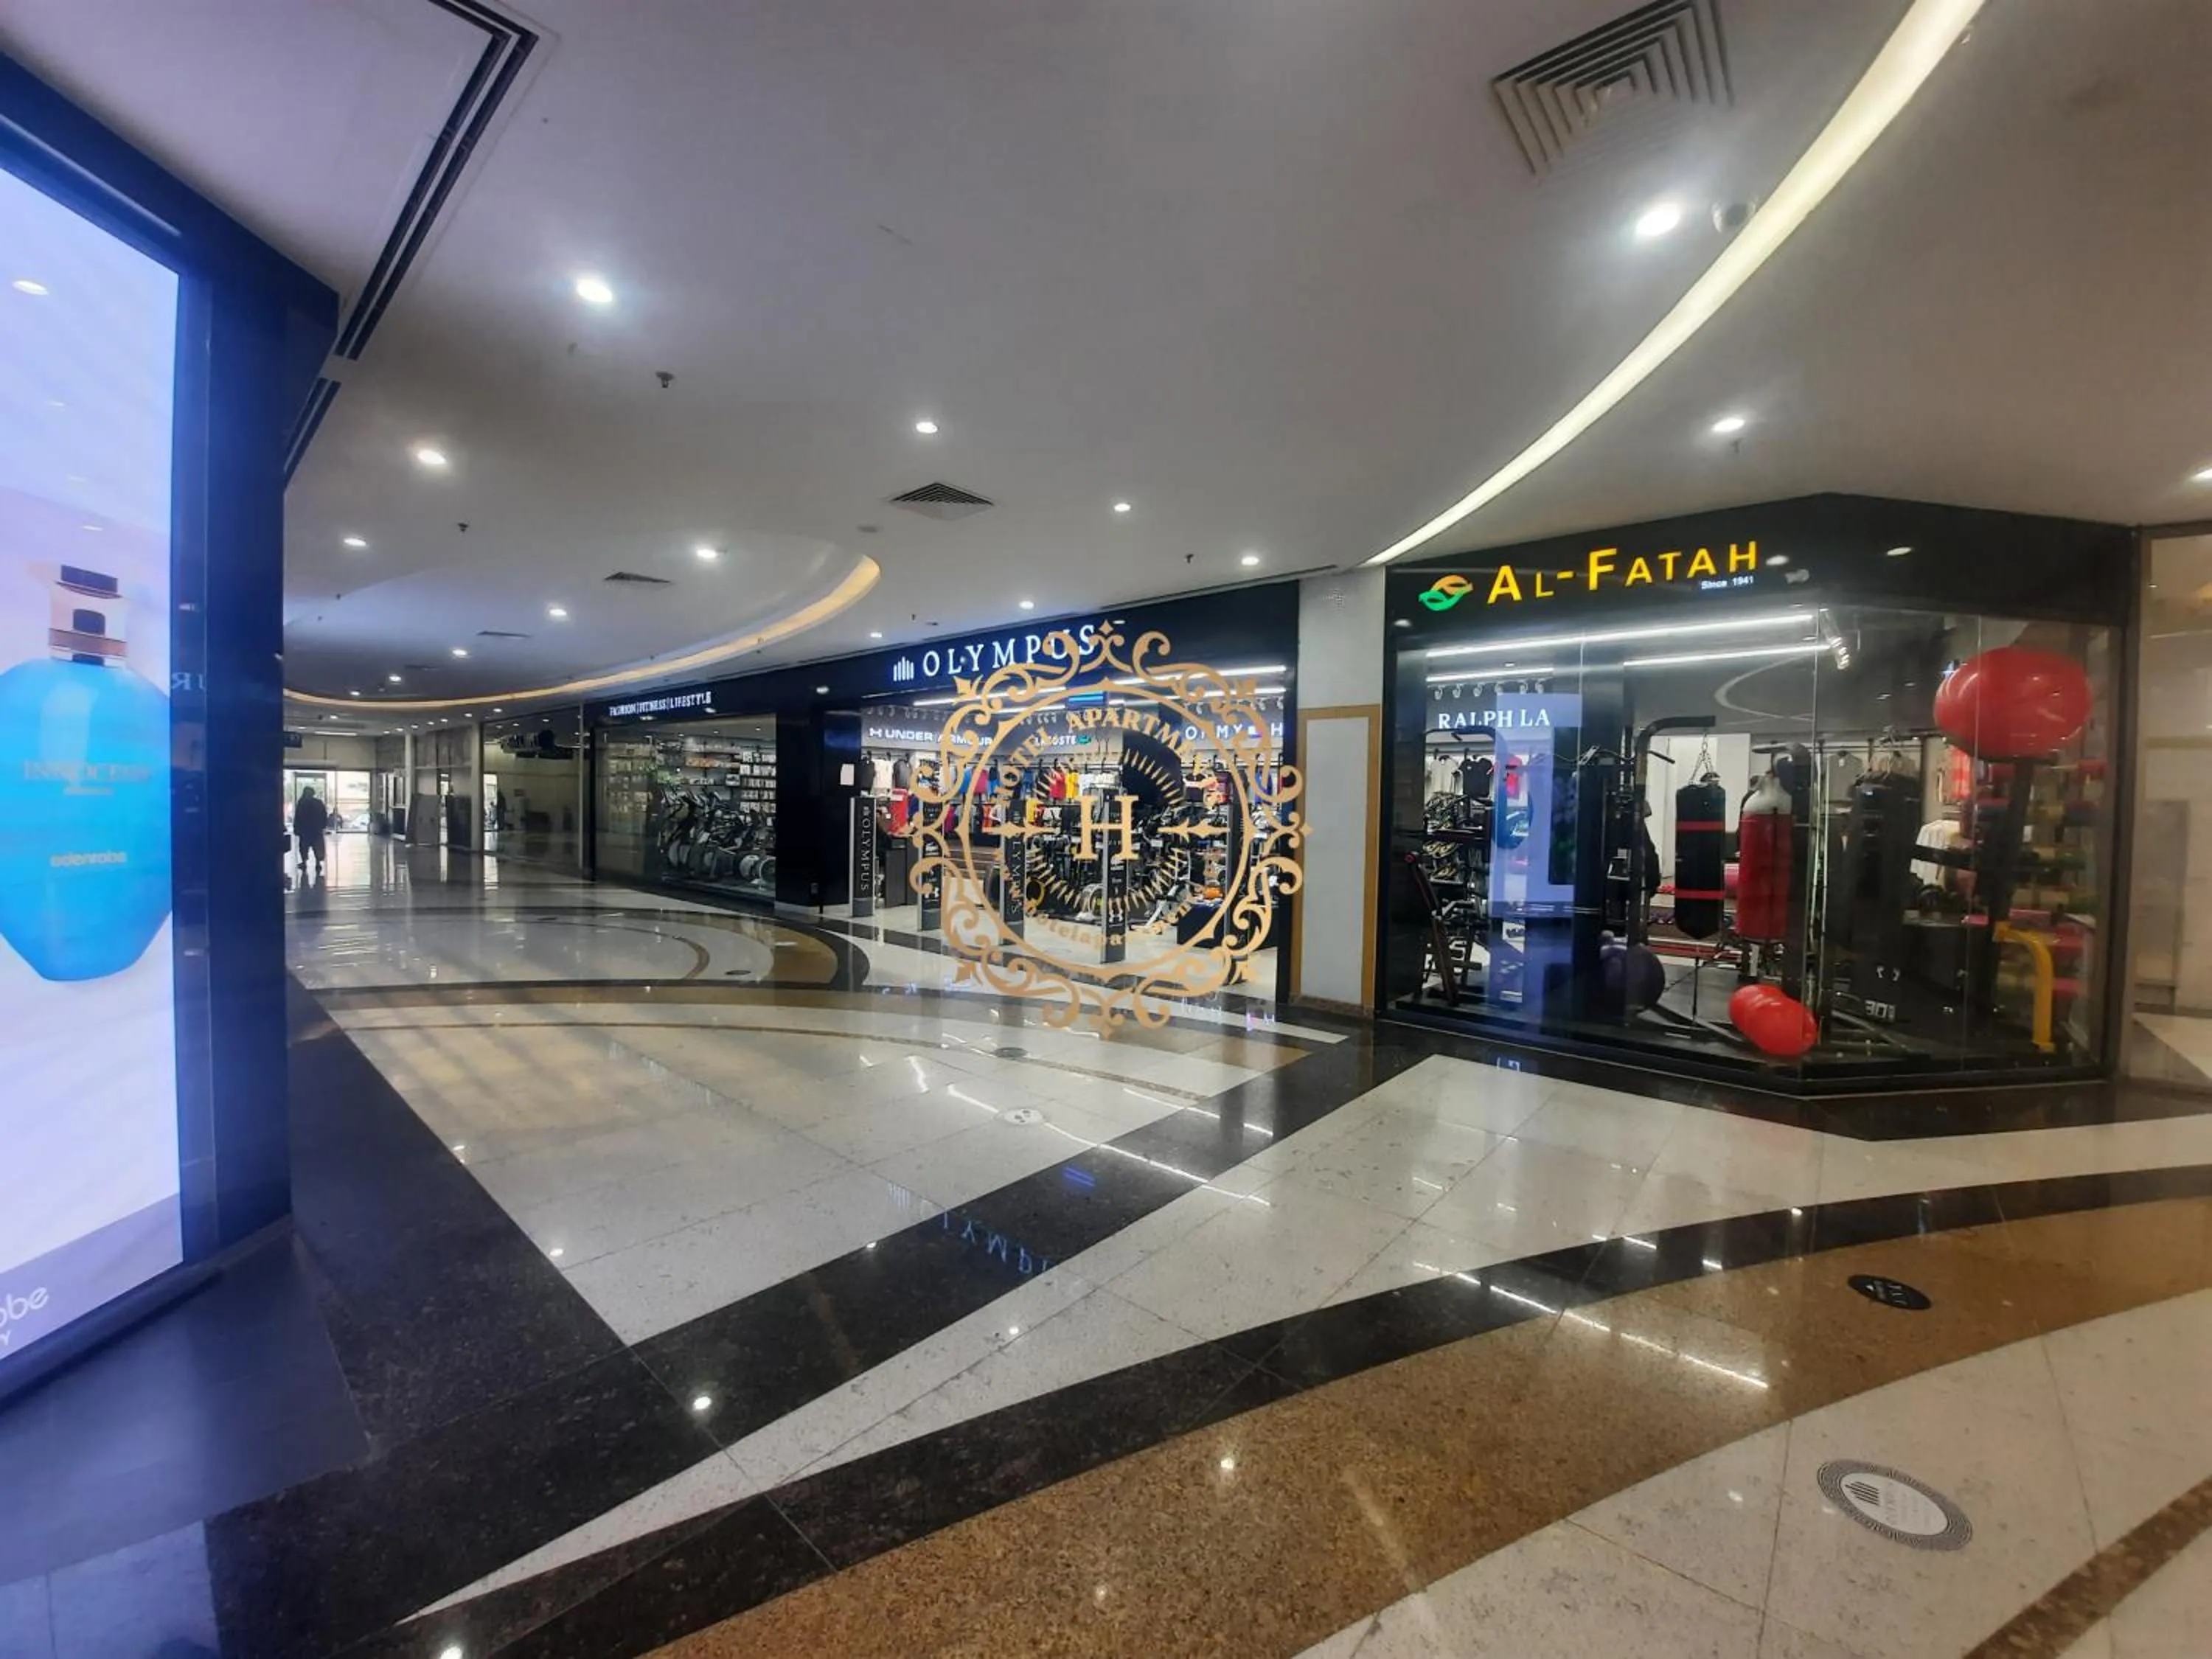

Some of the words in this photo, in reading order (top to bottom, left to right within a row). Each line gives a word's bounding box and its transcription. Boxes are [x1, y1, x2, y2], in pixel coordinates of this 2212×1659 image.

[1701, 580, 1728, 590] Since
[1733, 576, 1753, 586] 1941
[922, 625, 1095, 678] OLYMPUS
[1439, 710, 1514, 729] RALPH
[886, 728, 933, 742] UNDER
[860, 818, 872, 891] OLYMPUS
